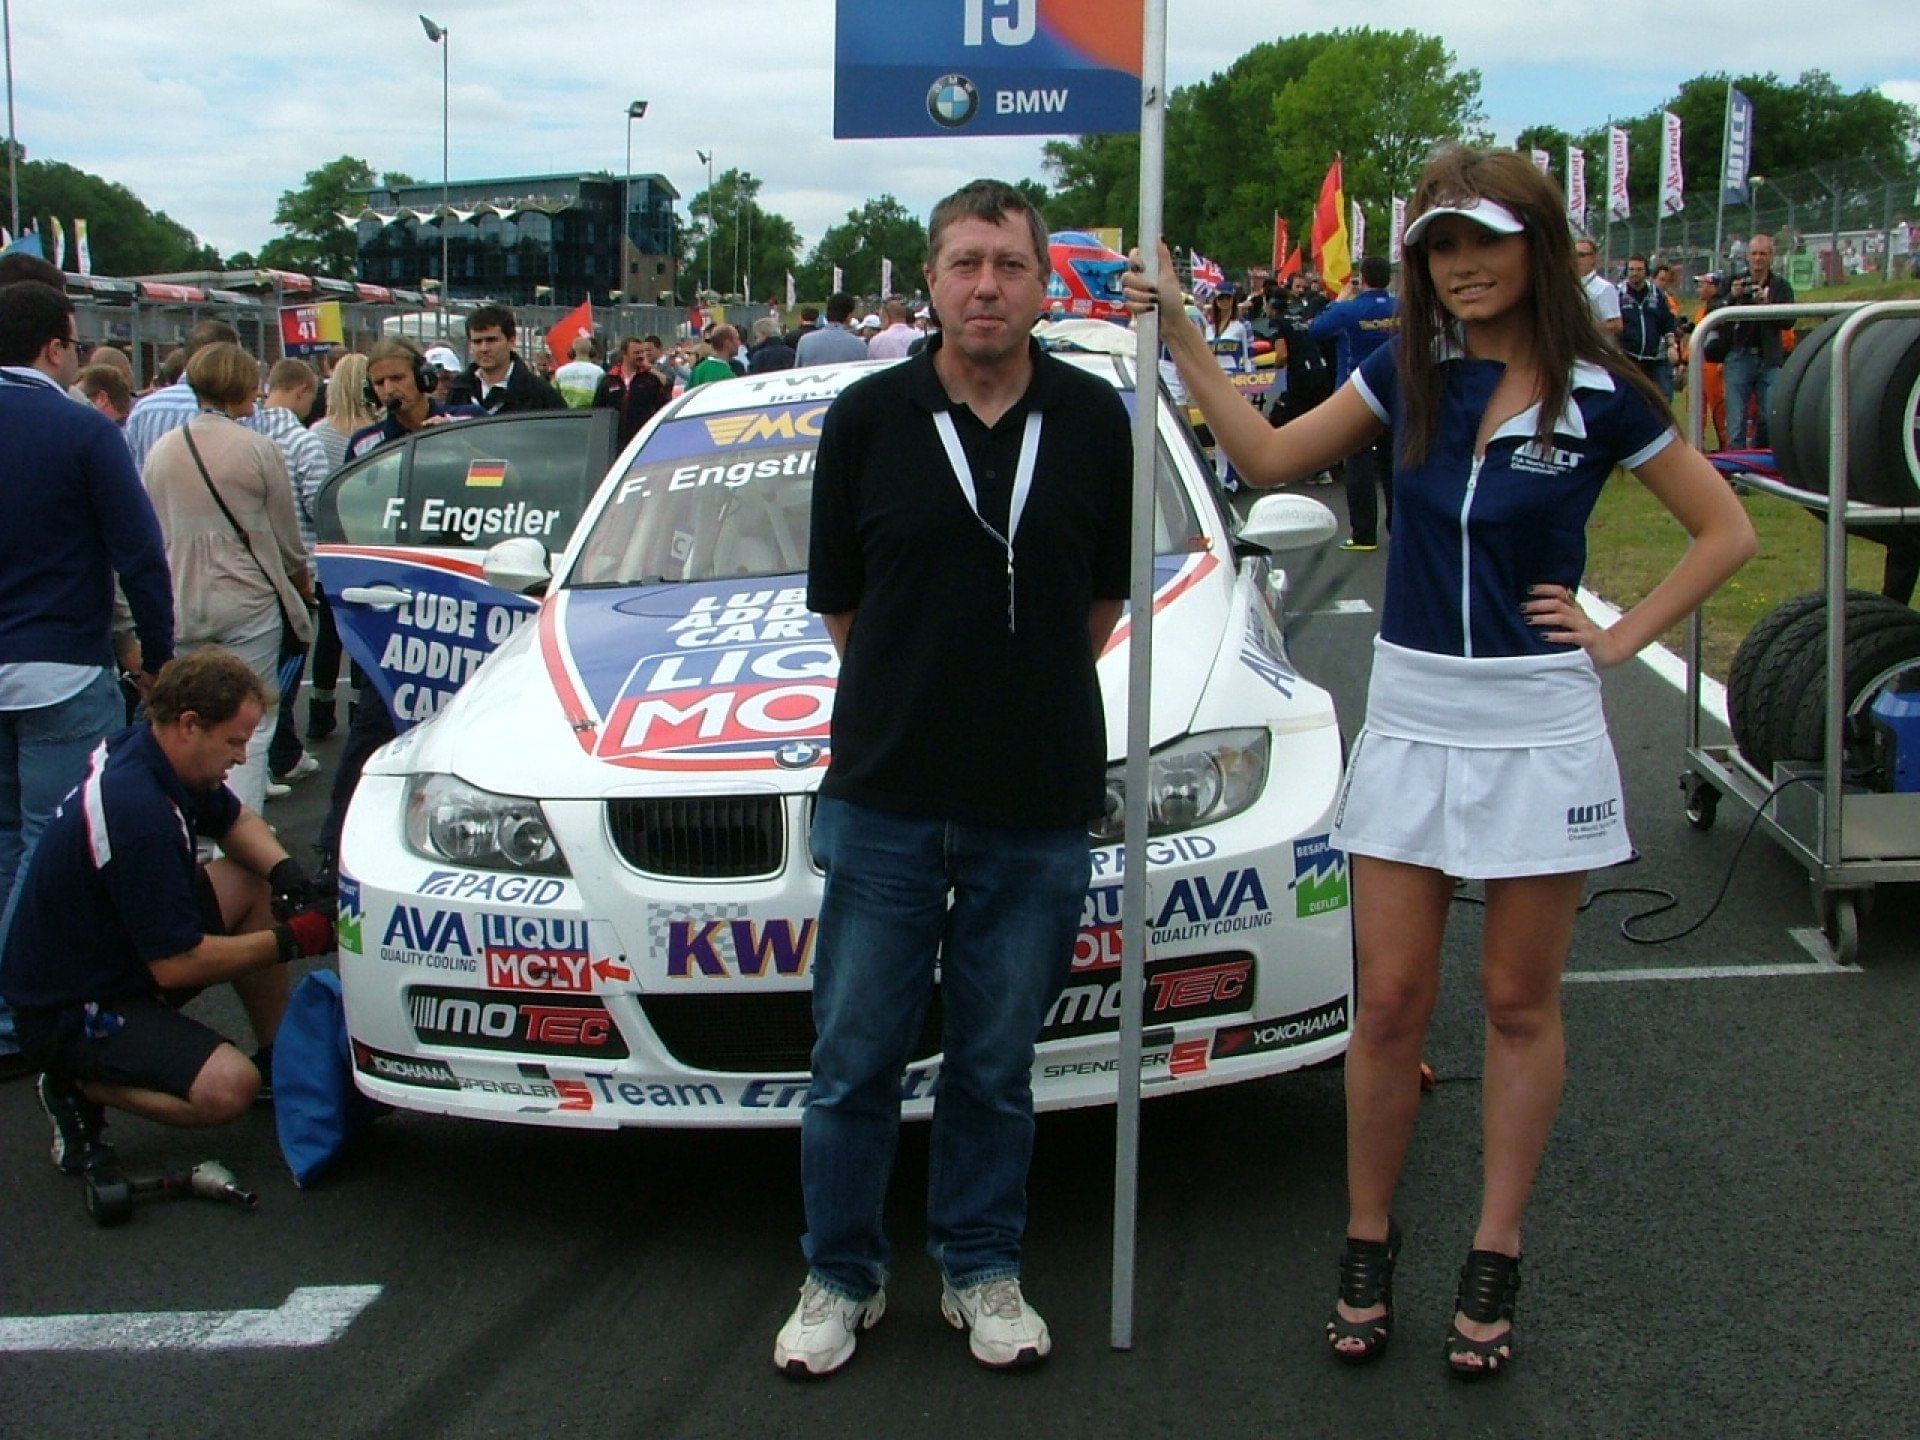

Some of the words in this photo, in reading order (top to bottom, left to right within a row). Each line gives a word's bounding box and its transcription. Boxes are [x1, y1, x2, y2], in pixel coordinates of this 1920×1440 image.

[995, 89, 1068, 114] BMW
[615, 475, 651, 504] F.
[668, 451, 816, 492] Engstl
[382, 498, 408, 530] F.
[419, 498, 560, 541] Engstler
[397, 590, 478, 639] LUBE
[667, 604, 822, 632] ADD
[688, 587, 809, 614] LUB
[675, 620, 810, 647] CAR
[381, 633, 491, 684] ADDIT
[646, 643, 841, 692] LIQ
[620, 684, 836, 749] MO
[449, 872, 565, 905] PAGID
[1156, 867, 1269, 928] AVA
[382, 904, 473, 957] AVA
[488, 914, 585, 950] LIQUI
[1151, 924, 1210, 946] QUALITY
[1214, 911, 1273, 935] COOLING
[381, 947, 425, 966] QUALITY
[426, 954, 478, 973] COOLING
[667, 917, 818, 979] KW
[1252, 1007, 1346, 1045] YOKOHAMA
[457, 1076, 557, 1099] SPENGLER
[584, 1071, 724, 1107] Team
